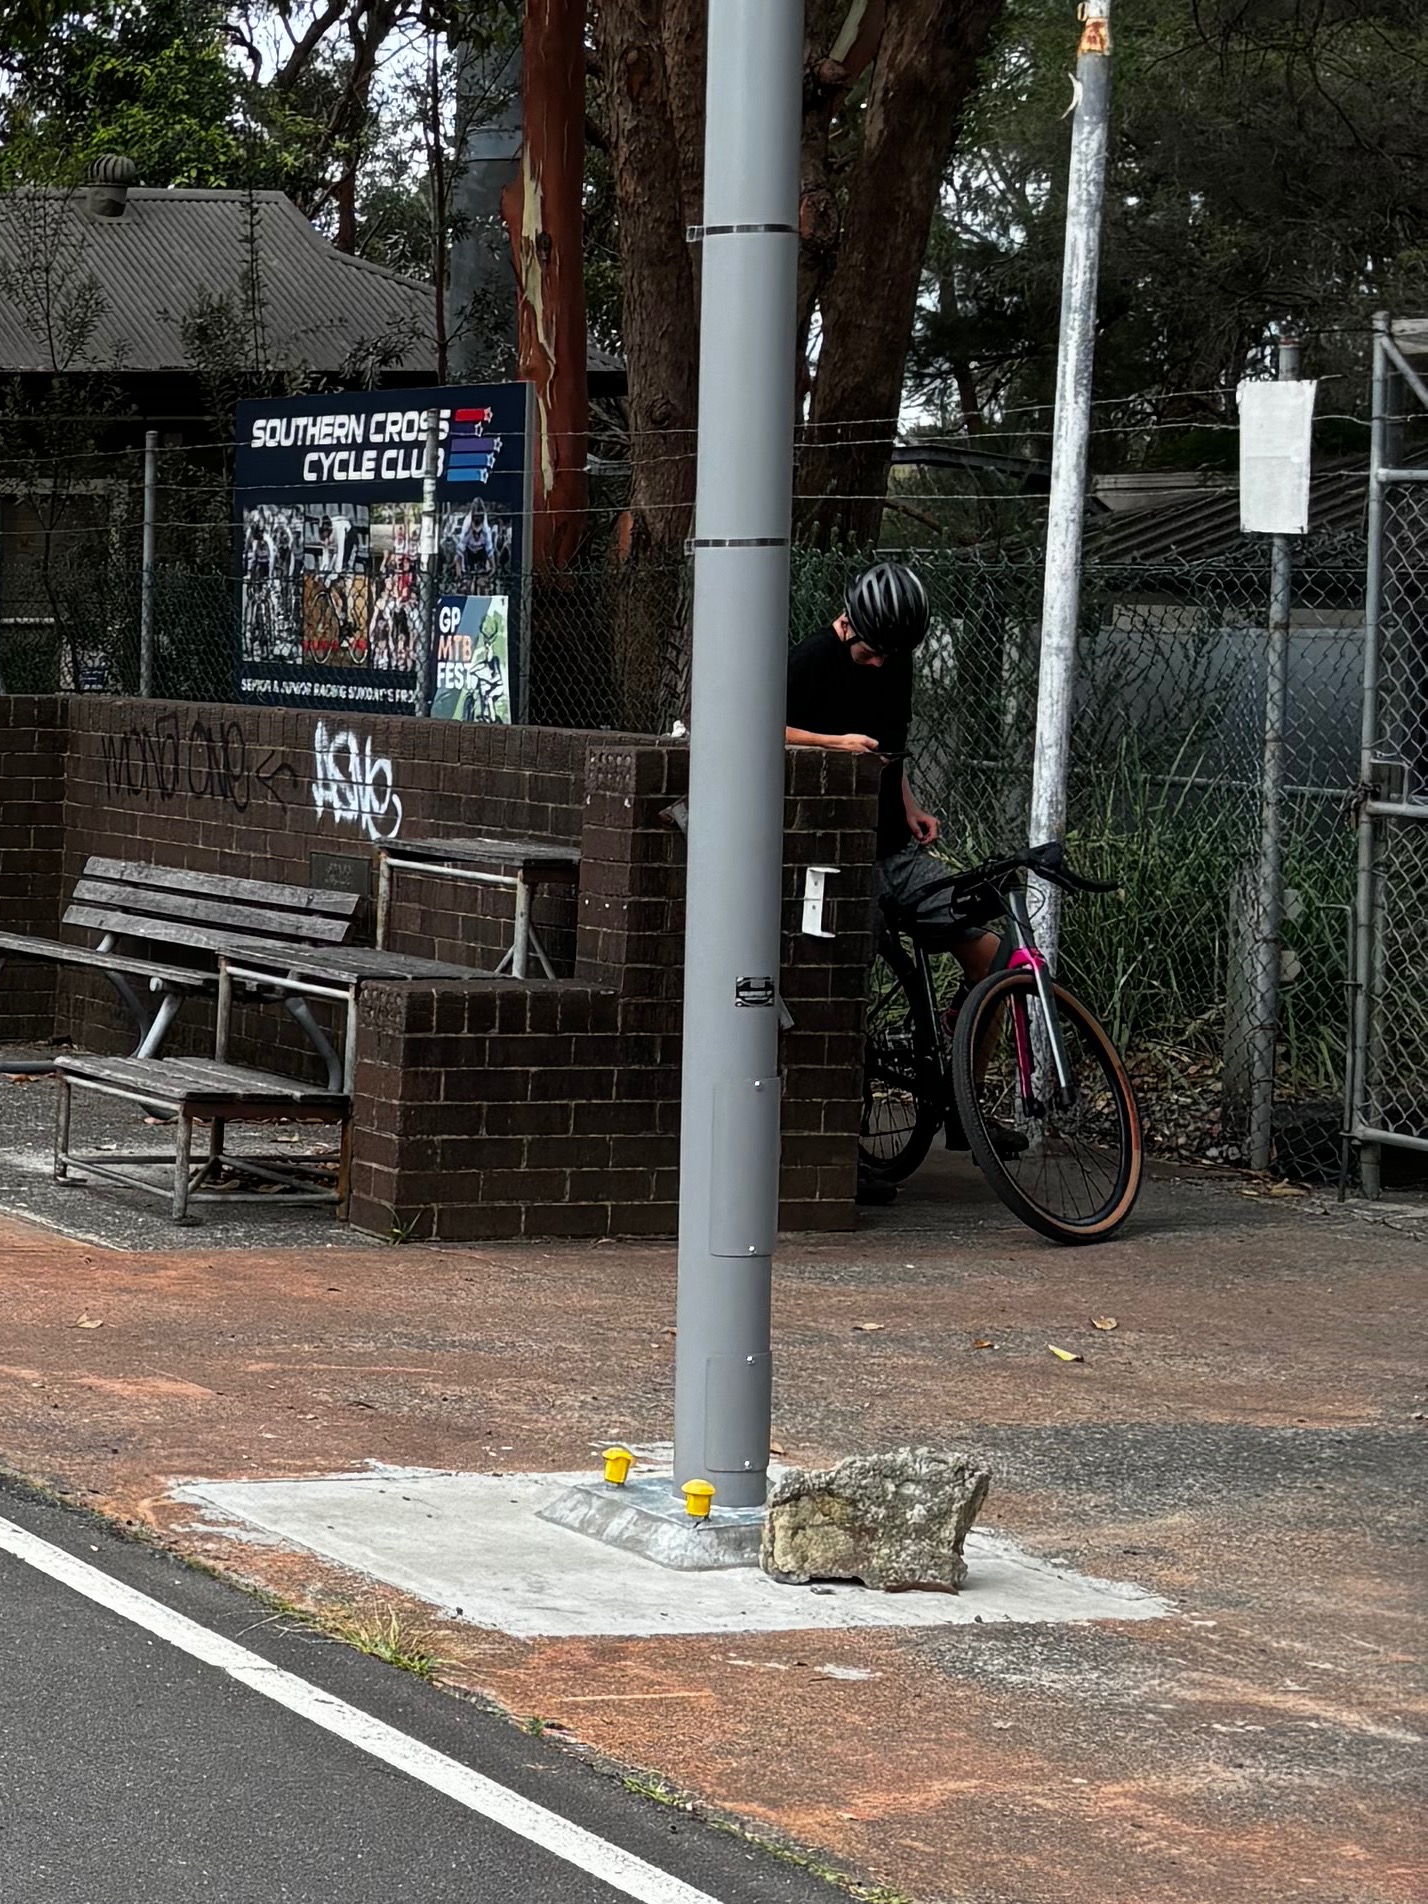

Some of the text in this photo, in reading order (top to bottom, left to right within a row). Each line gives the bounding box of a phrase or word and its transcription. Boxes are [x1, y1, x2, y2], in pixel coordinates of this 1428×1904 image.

[251, 413, 366, 448] SOUTHERN
[303, 450, 378, 481] CYCLE
[439, 606, 461, 633] GP
[438, 635, 472, 663] MTB
